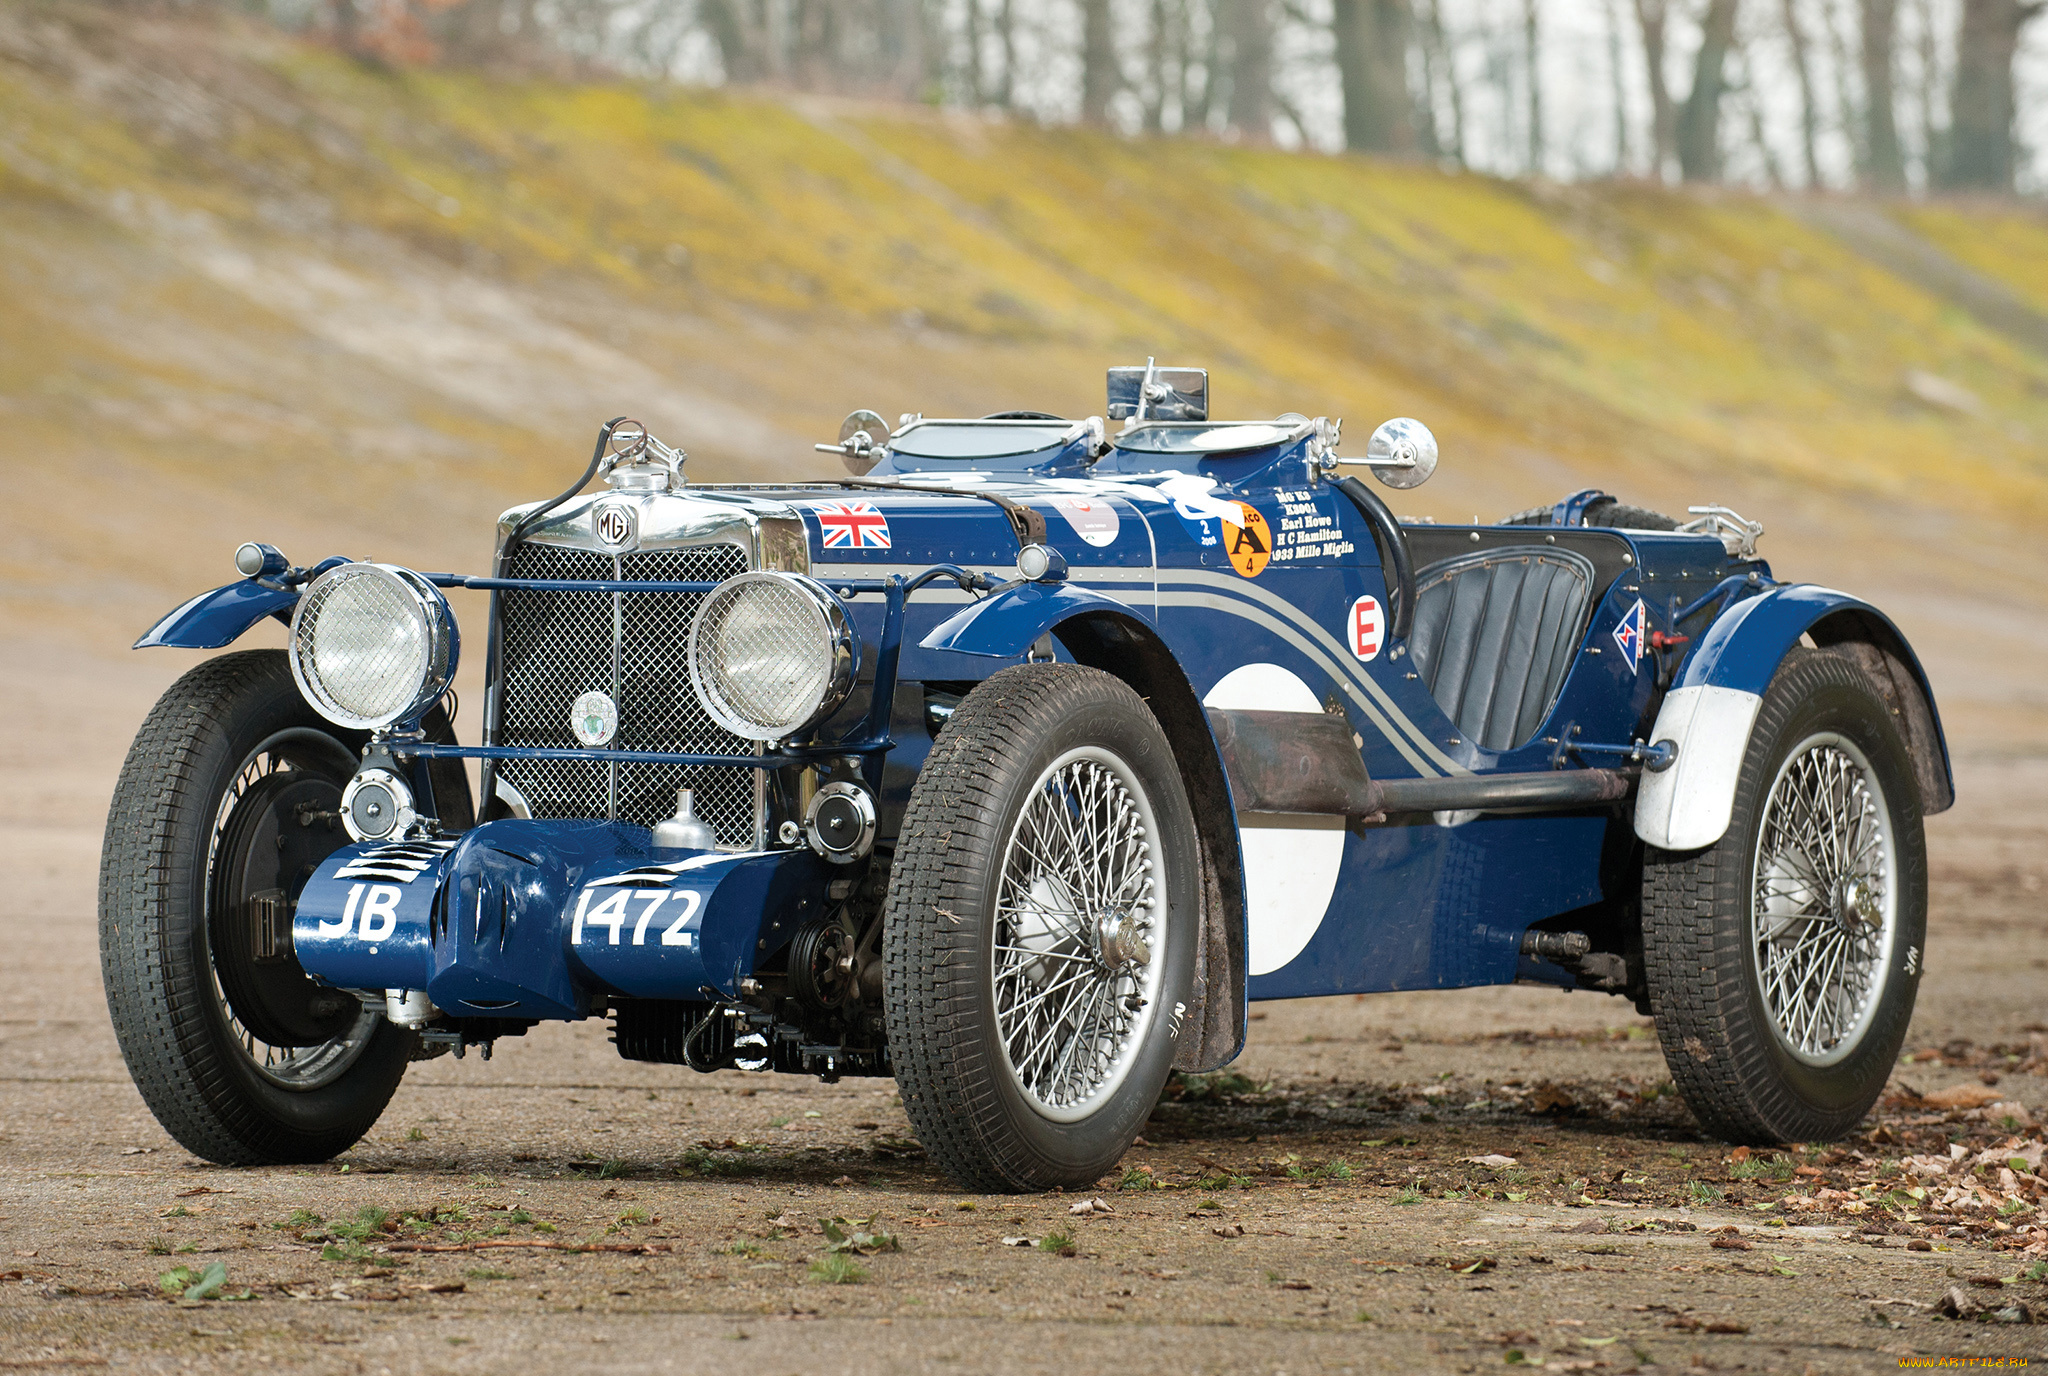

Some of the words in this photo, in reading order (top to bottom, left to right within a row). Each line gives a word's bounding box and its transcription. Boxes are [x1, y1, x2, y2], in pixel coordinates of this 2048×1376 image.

[1284, 502, 1317, 515] K3001
[600, 513, 624, 539] MG
[1199, 519, 1211, 535] 2
[1281, 517, 1304, 530] Earl
[1304, 515, 1332, 528] Howe
[1230, 526, 1269, 555] A
[1277, 533, 1286, 546] H
[1287, 532, 1295, 545] C
[1296, 529, 1343, 544] Hamilton
[1295, 545, 1321, 559] Mille
[1322, 541, 1355, 558] Miglia
[1246, 558, 1254, 573] 4
[1356, 601, 1376, 656] E
[318, 883, 402, 942] JB
[571, 888, 701, 946] 1472
